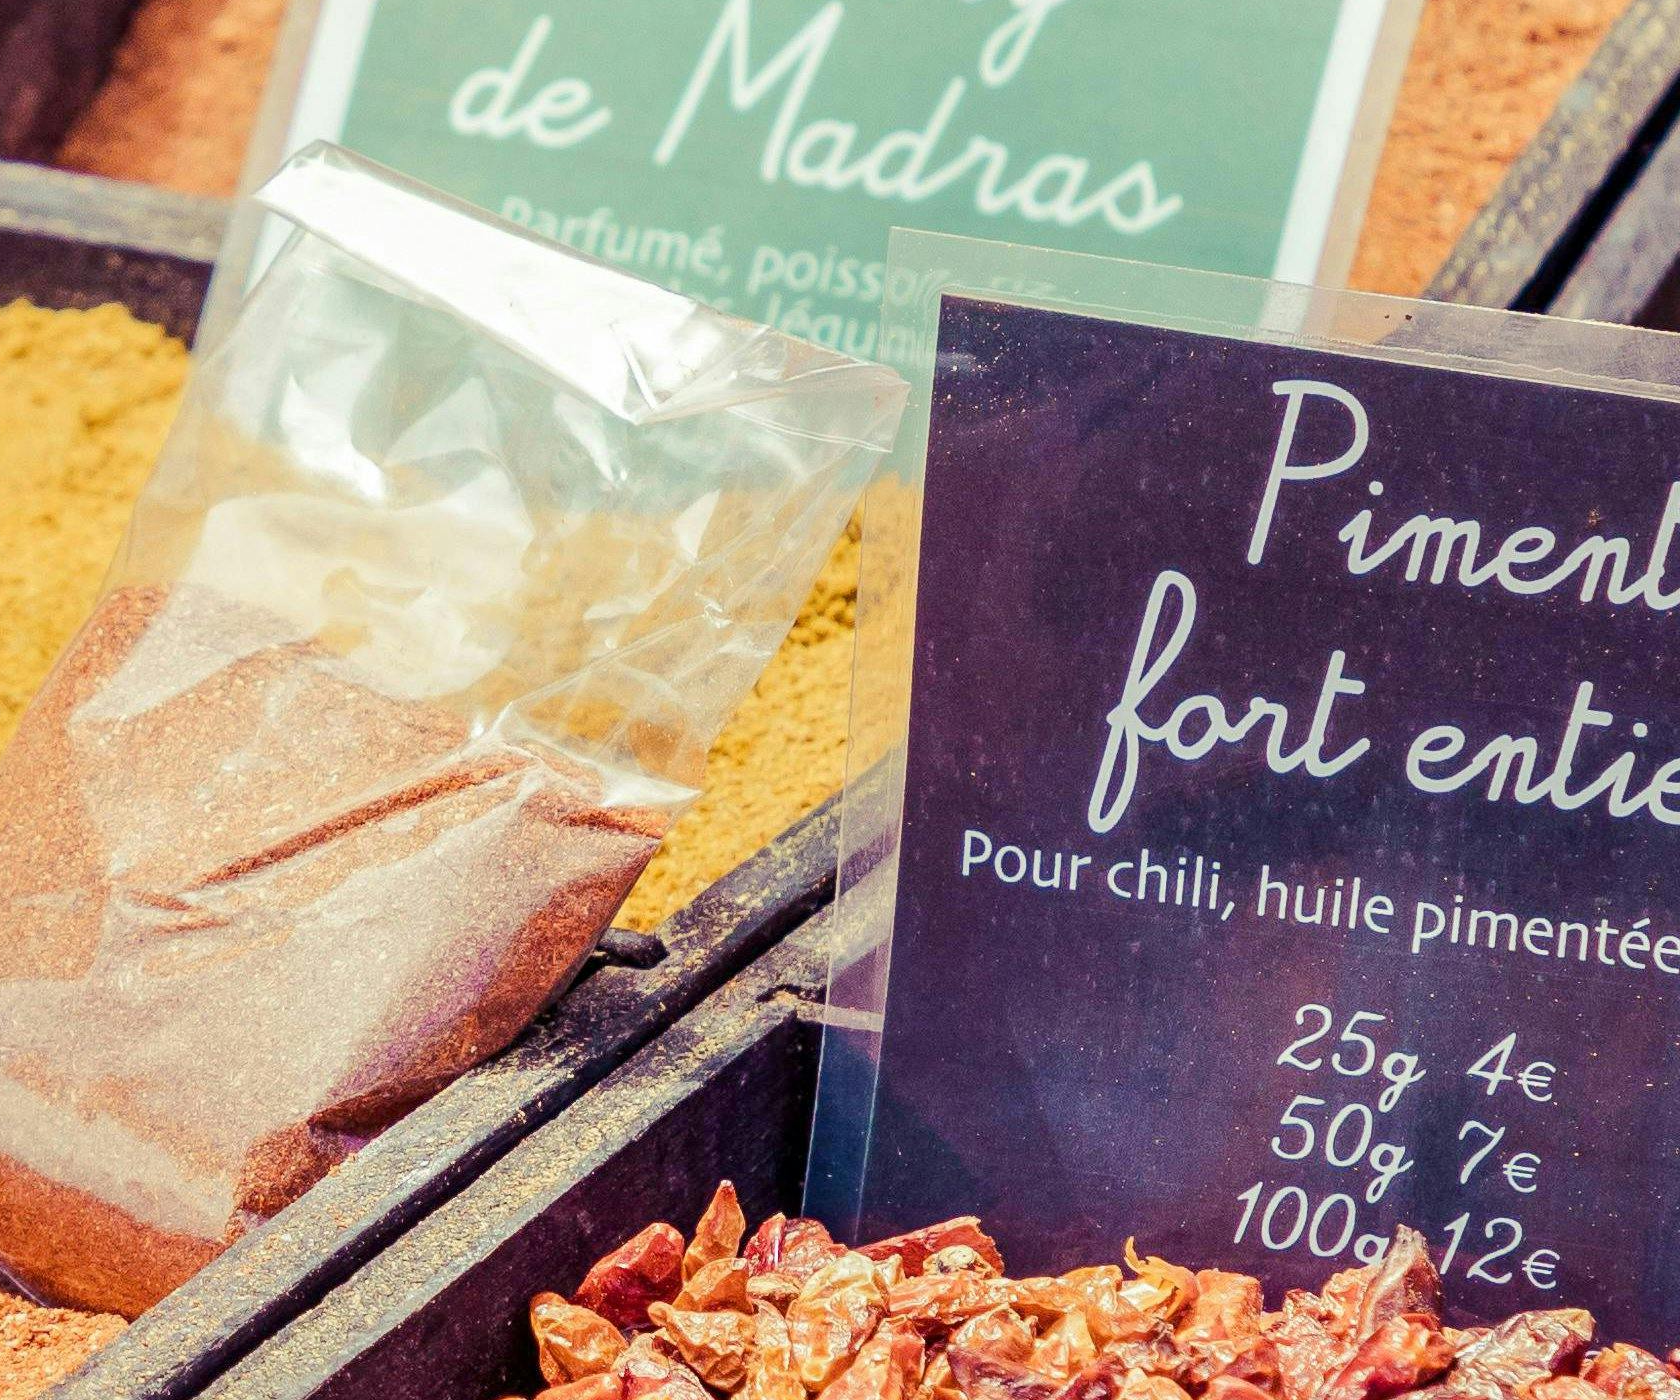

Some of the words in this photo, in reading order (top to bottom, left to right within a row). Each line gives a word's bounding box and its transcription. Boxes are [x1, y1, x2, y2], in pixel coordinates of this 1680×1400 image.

[448, 14, 612, 149] de
[1087, 570, 1371, 834] fort
[960, 828, 1092, 893] Pour
[1106, 847, 1236, 920] chili,
[1257, 867, 1395, 936] huile
[1276, 1002, 1426, 1114] 25g
[1465, 1032, 1558, 1105] 4€
[1270, 1092, 1413, 1202] 50g
[1455, 1119, 1543, 1195] 7€
[1439, 1211, 1561, 1290] 12€
